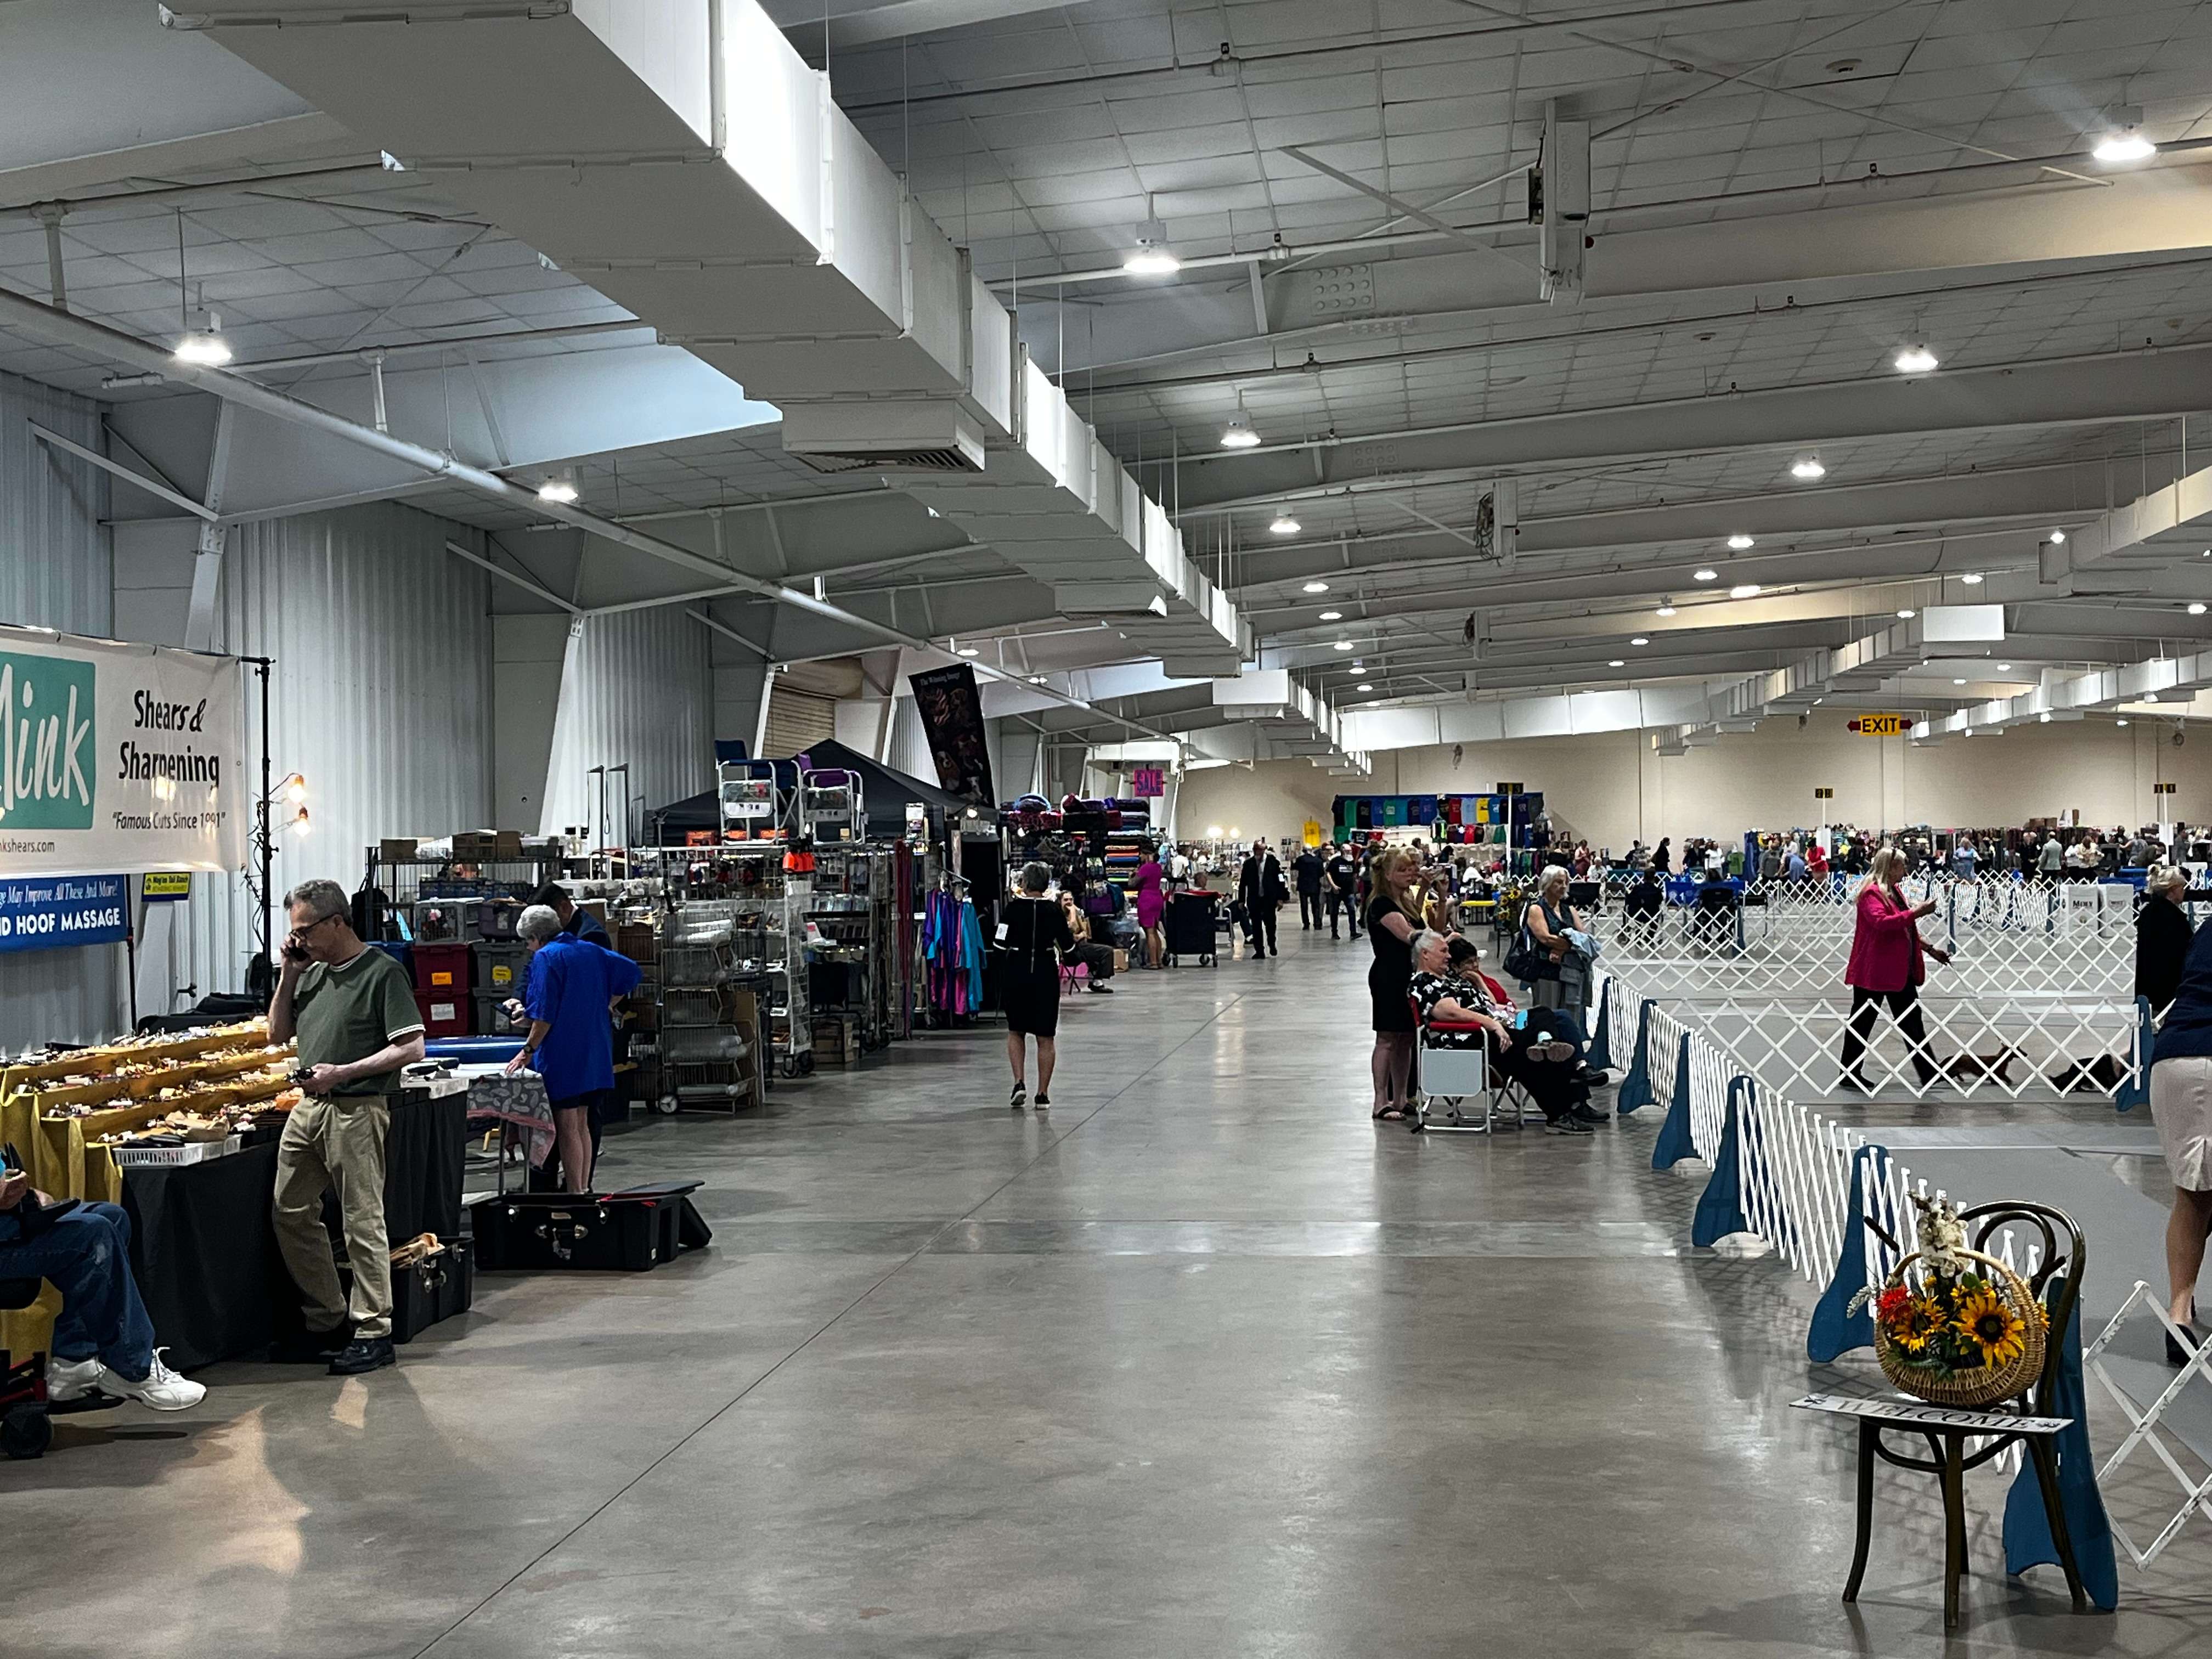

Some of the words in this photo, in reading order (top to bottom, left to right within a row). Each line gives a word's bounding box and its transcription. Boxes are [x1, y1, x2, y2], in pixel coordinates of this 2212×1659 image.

[134, 690, 190, 731] Shears
[189, 698, 207, 732] &
[1862, 718, 1898, 733] EXIT
[119, 741, 219, 791] Sharpening
[153, 812, 171, 830] Cuts
[173, 812, 198, 829] Since
[7, 885, 24, 909] May
[25, 885, 52, 907] Improve
[16, 913, 55, 935] HOOF
[61, 907, 121, 932] MASSAGE
[1837, 1401, 2035, 1430] WELCOME
